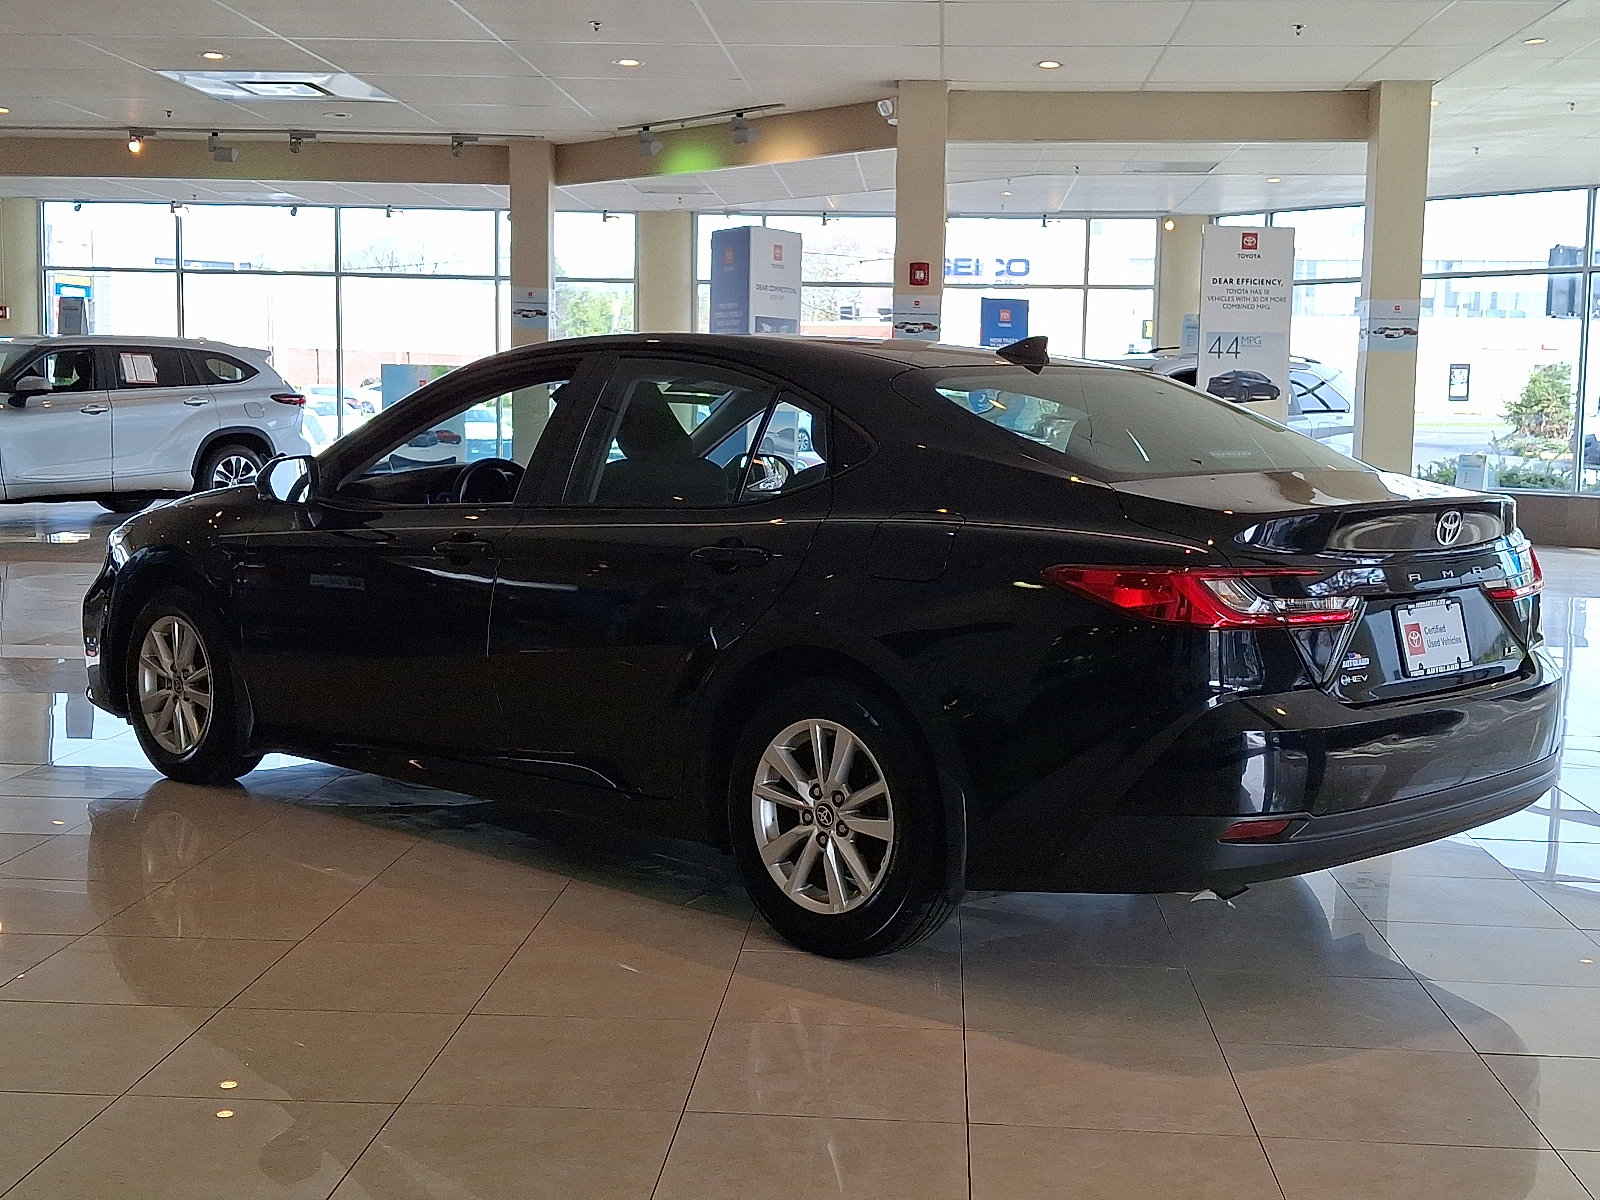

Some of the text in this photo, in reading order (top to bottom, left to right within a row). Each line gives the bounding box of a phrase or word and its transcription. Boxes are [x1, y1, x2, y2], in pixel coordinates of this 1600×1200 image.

[1212, 277, 1284, 287] DEAR EFFICIENCY,
[1208, 335, 1262, 360] 44 MPG
[1423, 624, 1447, 635] Certified
[1426, 635, 1462, 649] Used Vehicles
[1504, 645, 1517, 657] LE
[1426, 662, 1460, 675] AUTOLAND
